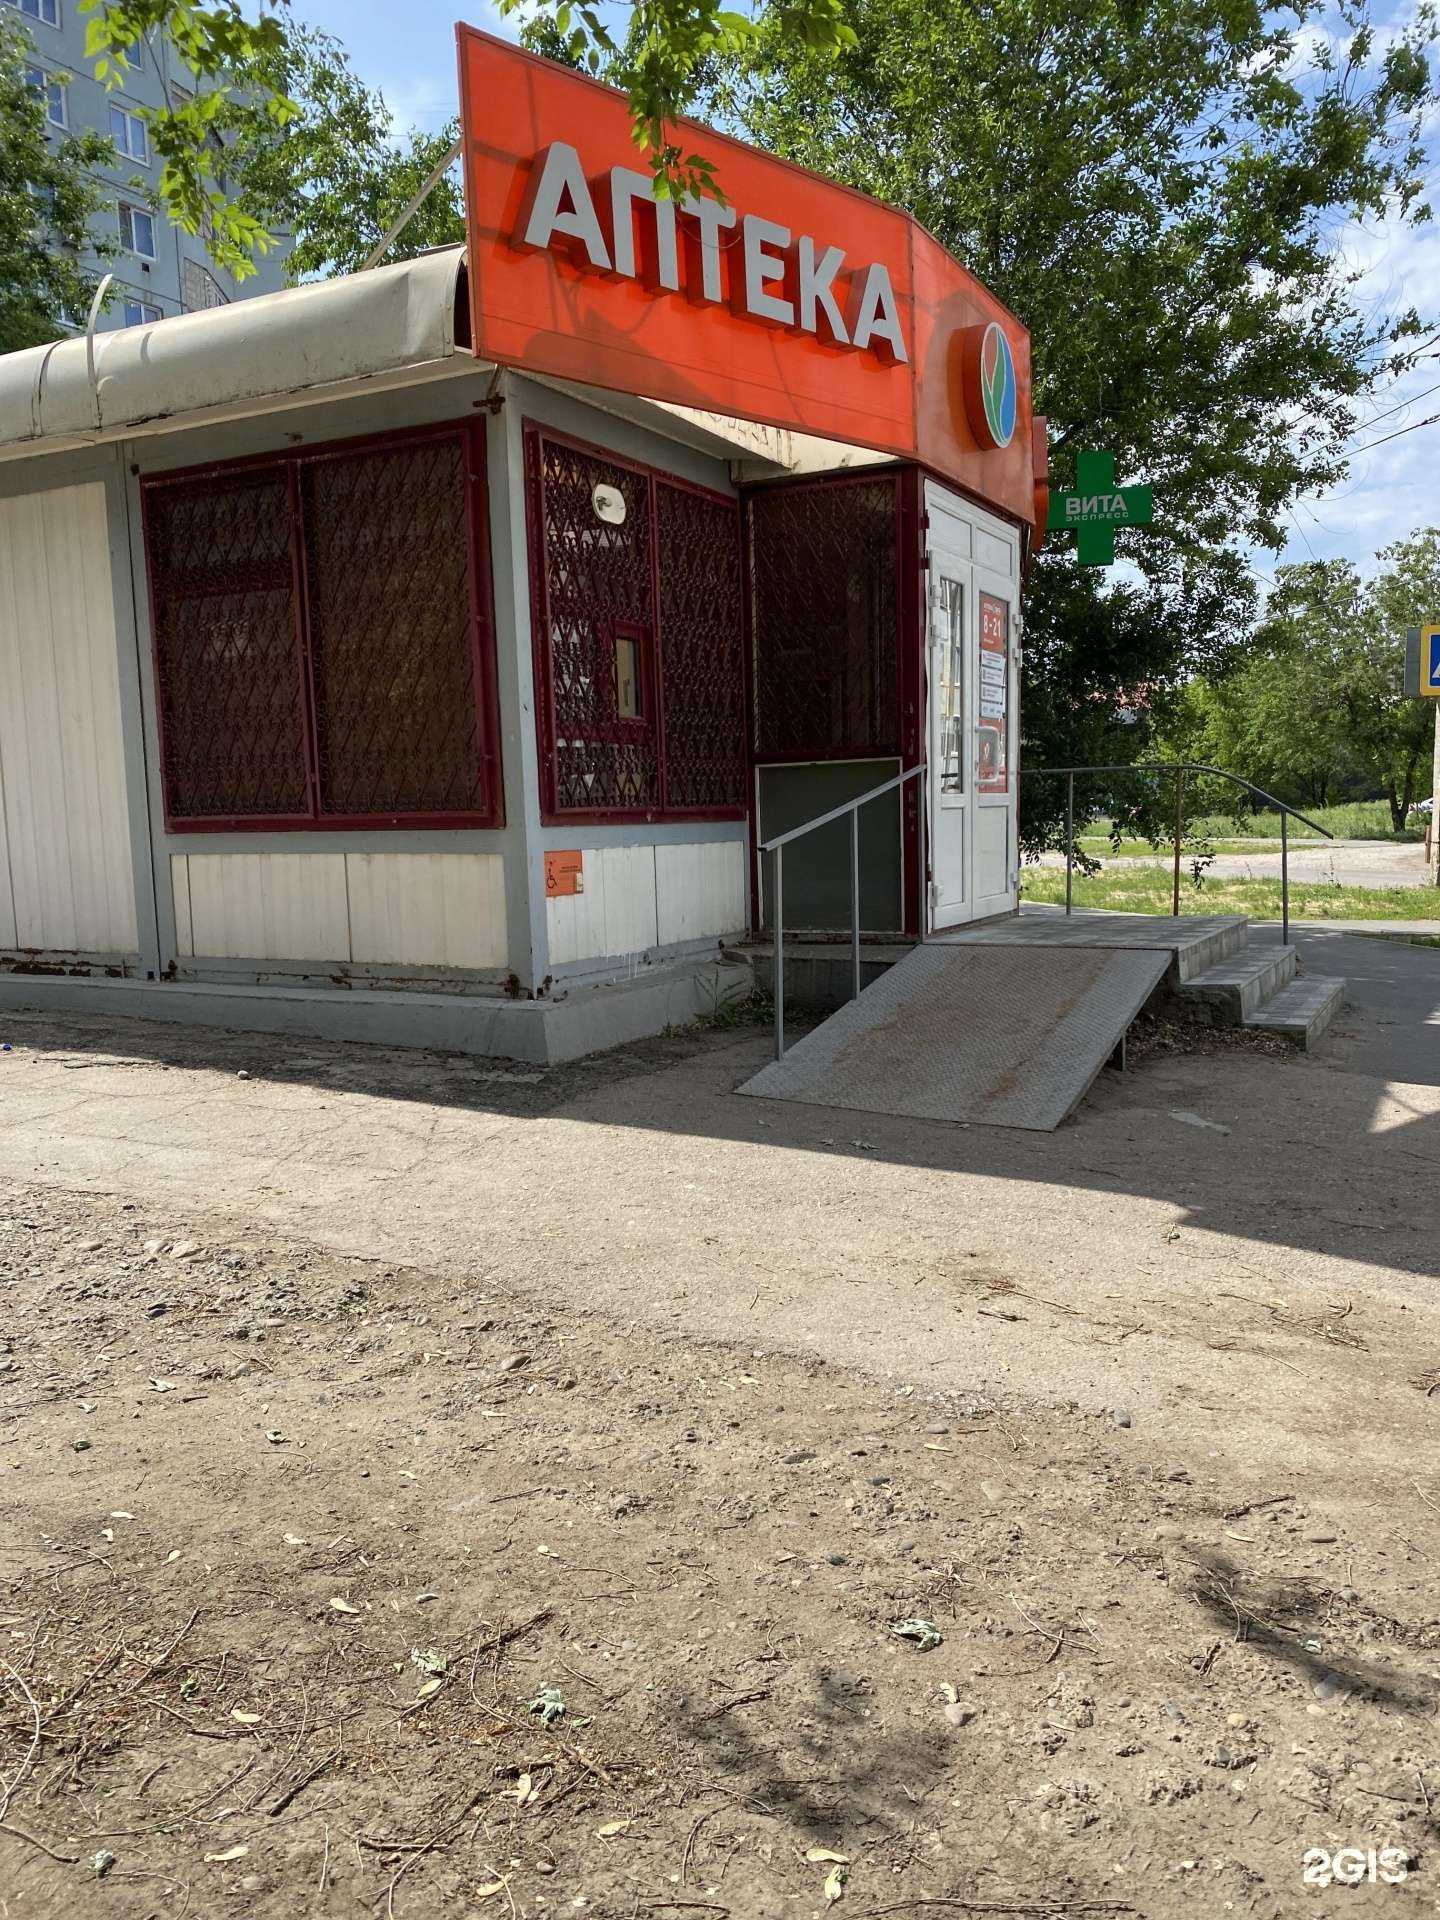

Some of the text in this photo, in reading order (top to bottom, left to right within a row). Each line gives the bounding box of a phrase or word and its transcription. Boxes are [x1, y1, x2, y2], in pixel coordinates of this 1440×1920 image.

[524, 141, 908, 363] АПТЕКА
[1065, 494, 1127, 515] ВИТА
[1065, 511, 1129, 522] ЭКСПРЕСС
